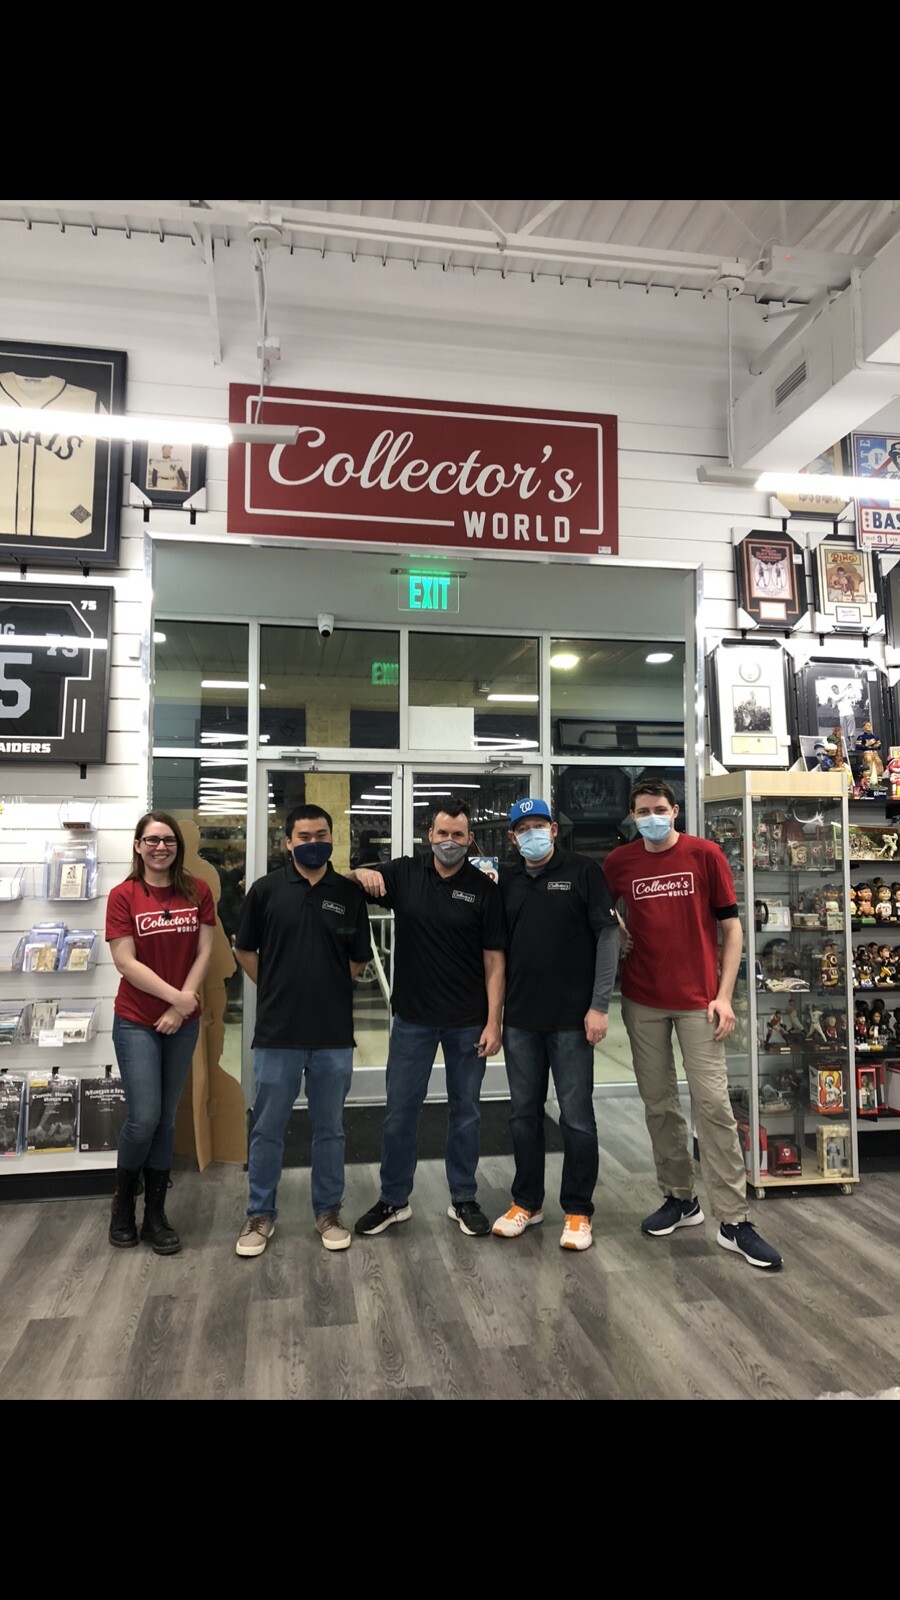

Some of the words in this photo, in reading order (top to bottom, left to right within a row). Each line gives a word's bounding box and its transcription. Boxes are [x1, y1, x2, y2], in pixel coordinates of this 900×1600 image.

[268, 426, 582, 503] Collector's
[463, 510, 570, 543] WORLD
[409, 576, 450, 610] EXIT
[81, 601, 97, 611] 75
[635, 877, 689, 894] Collector's
[85, 1088, 125, 1096] Magazin
